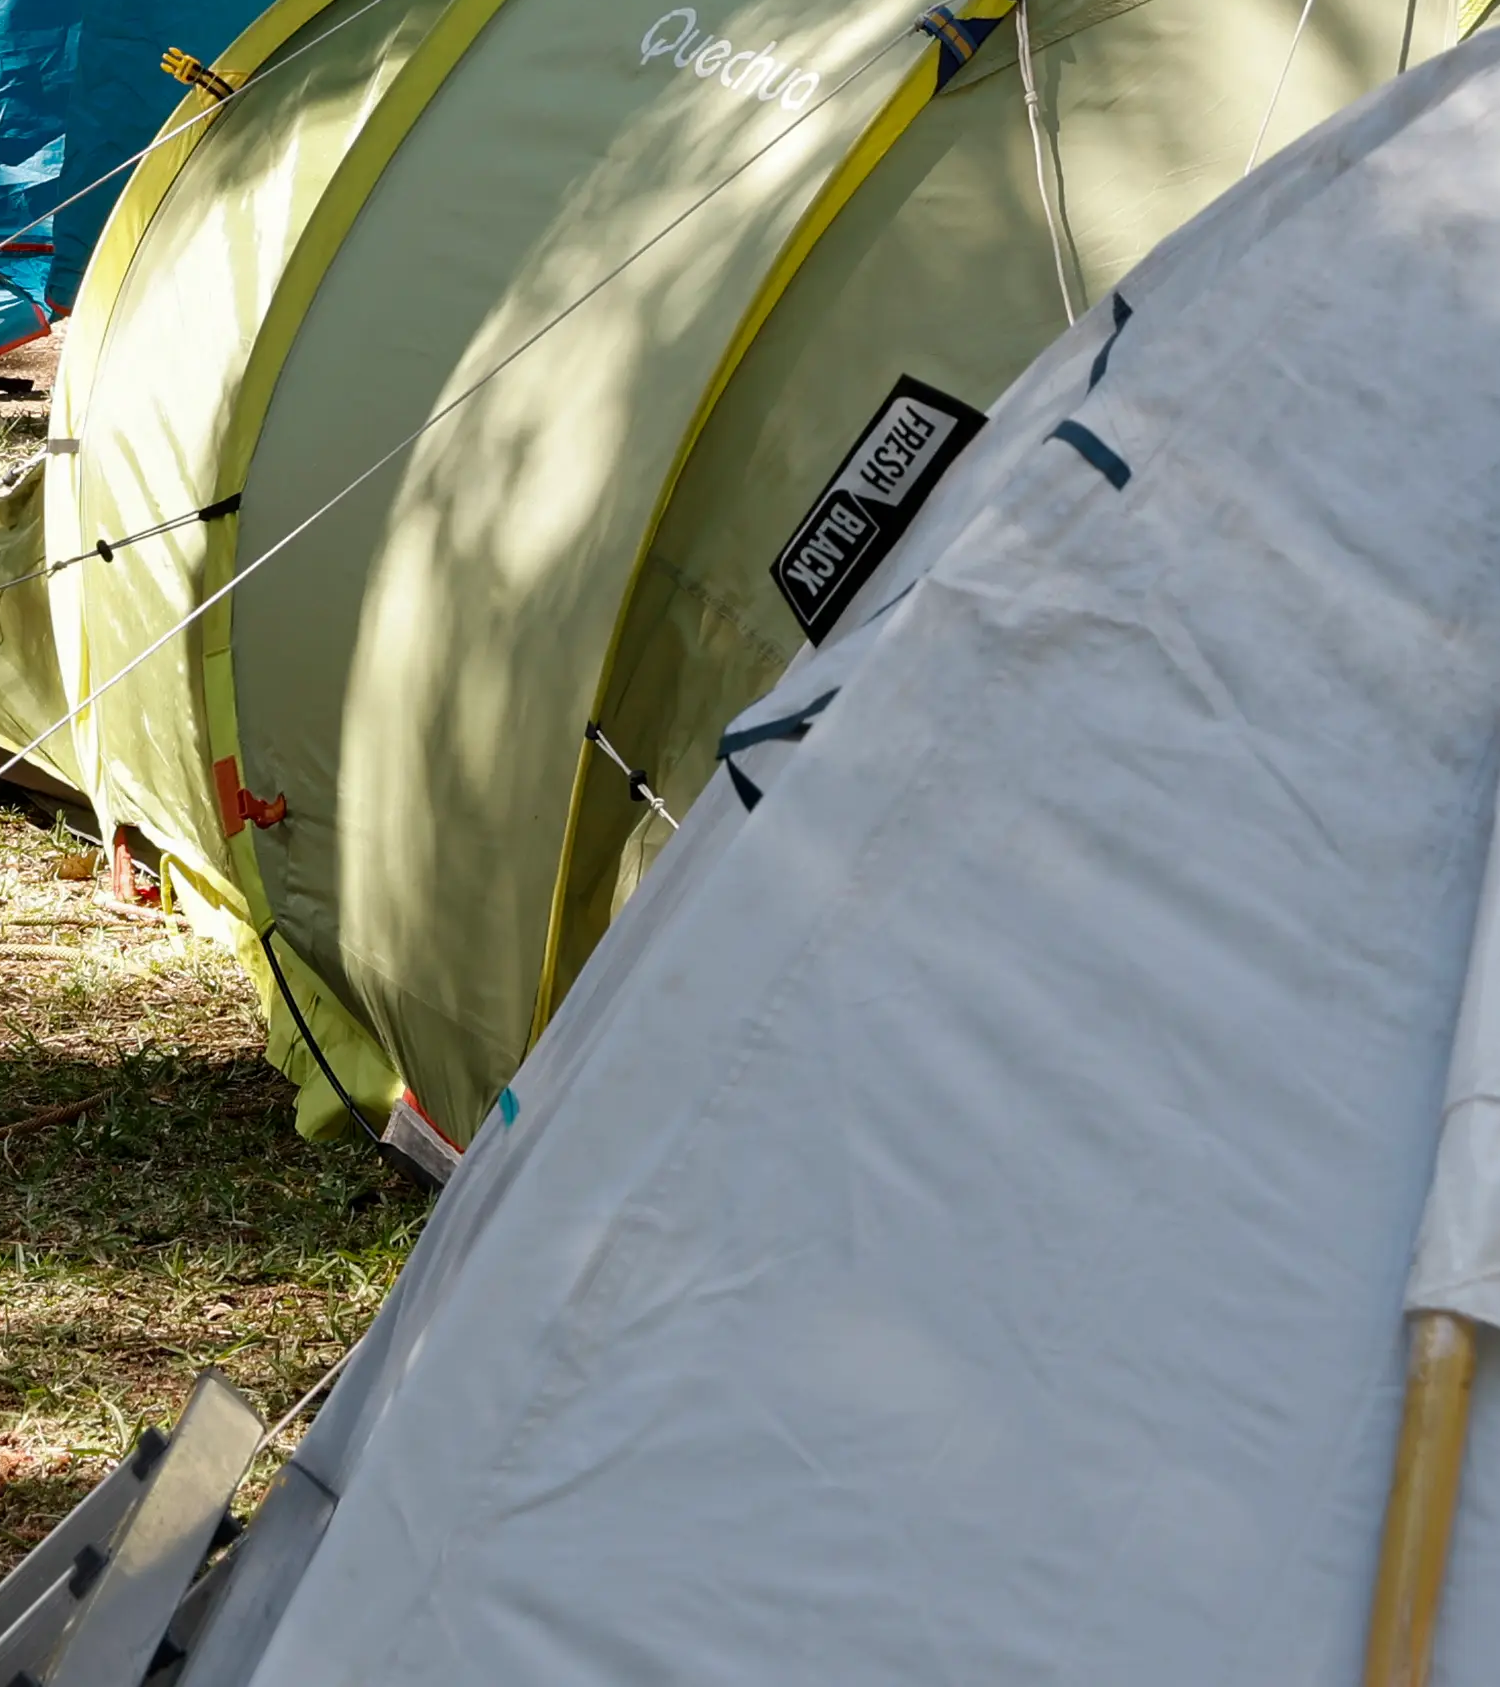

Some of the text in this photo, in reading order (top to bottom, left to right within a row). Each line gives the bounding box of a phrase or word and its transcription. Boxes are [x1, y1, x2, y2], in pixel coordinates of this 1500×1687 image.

[640, 7, 820, 111] Quechua
[786, 405, 936, 597] FRESH BLACK
